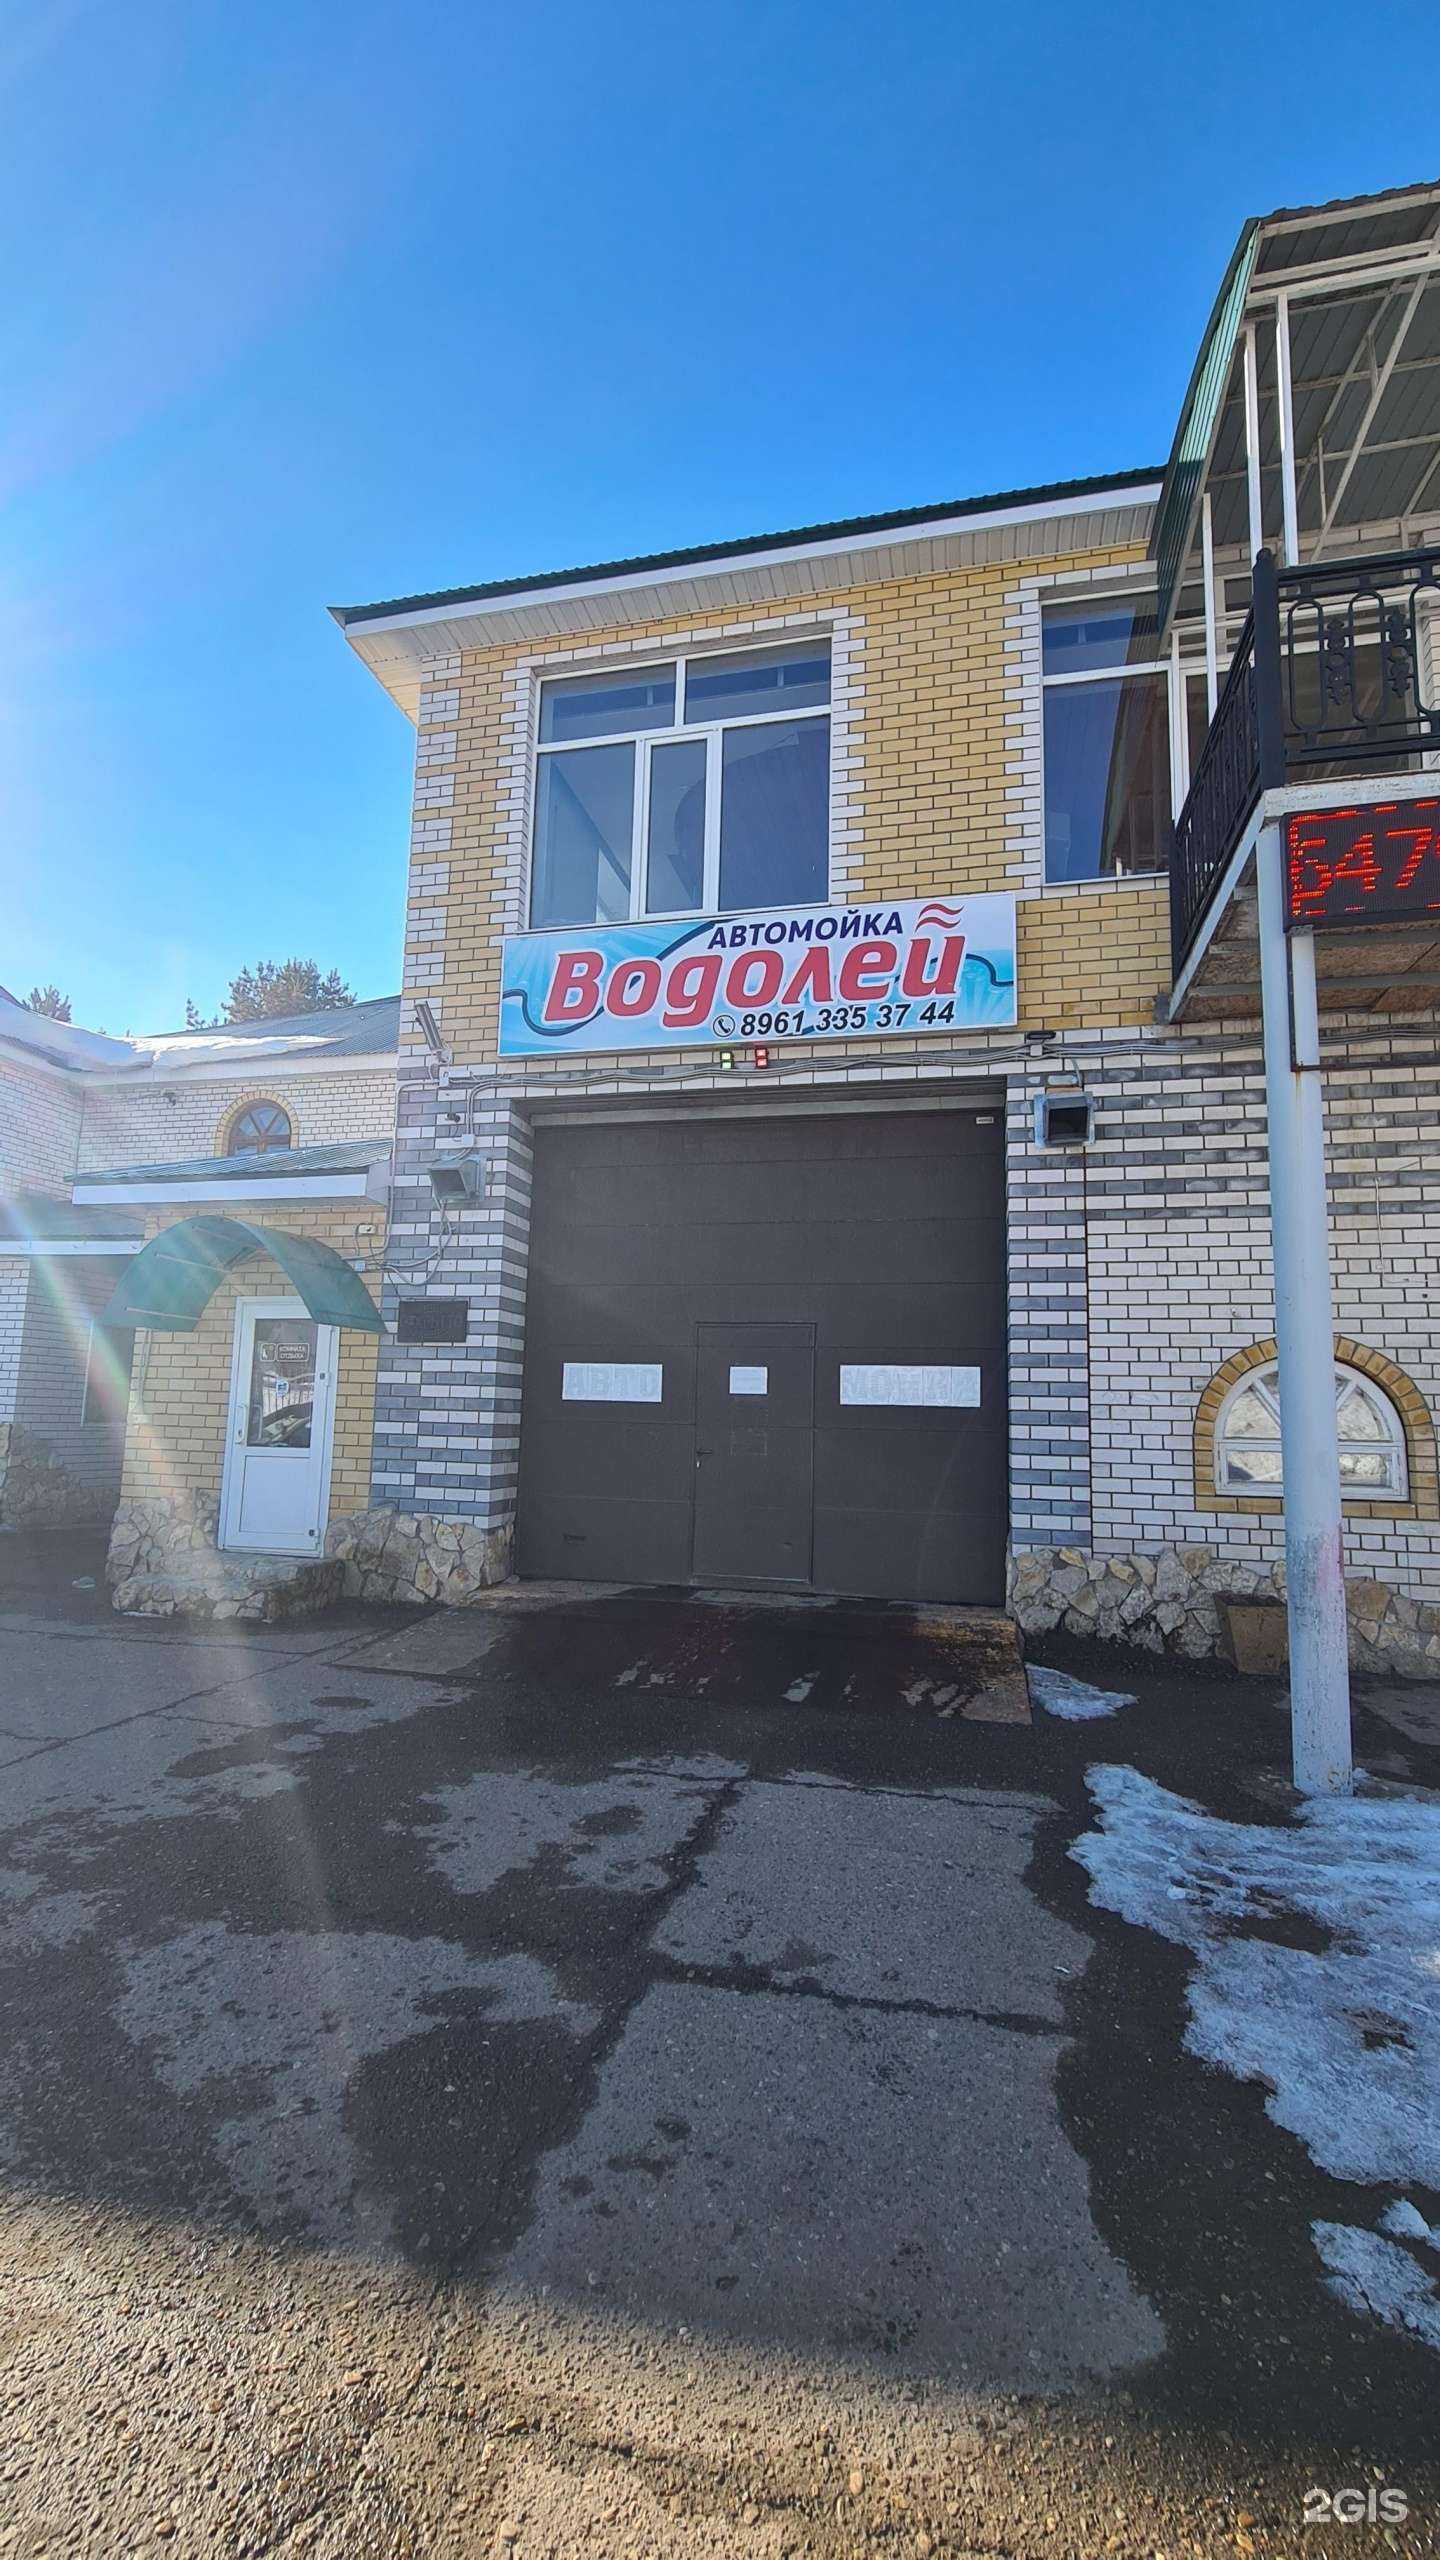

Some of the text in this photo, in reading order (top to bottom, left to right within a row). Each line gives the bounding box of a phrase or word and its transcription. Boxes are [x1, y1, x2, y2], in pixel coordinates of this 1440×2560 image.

[707, 910, 904, 950] АВТОМОЙКА
[544, 903, 967, 1028] Водолей
[740, 1000, 955, 1036] 8961 335 37 44
